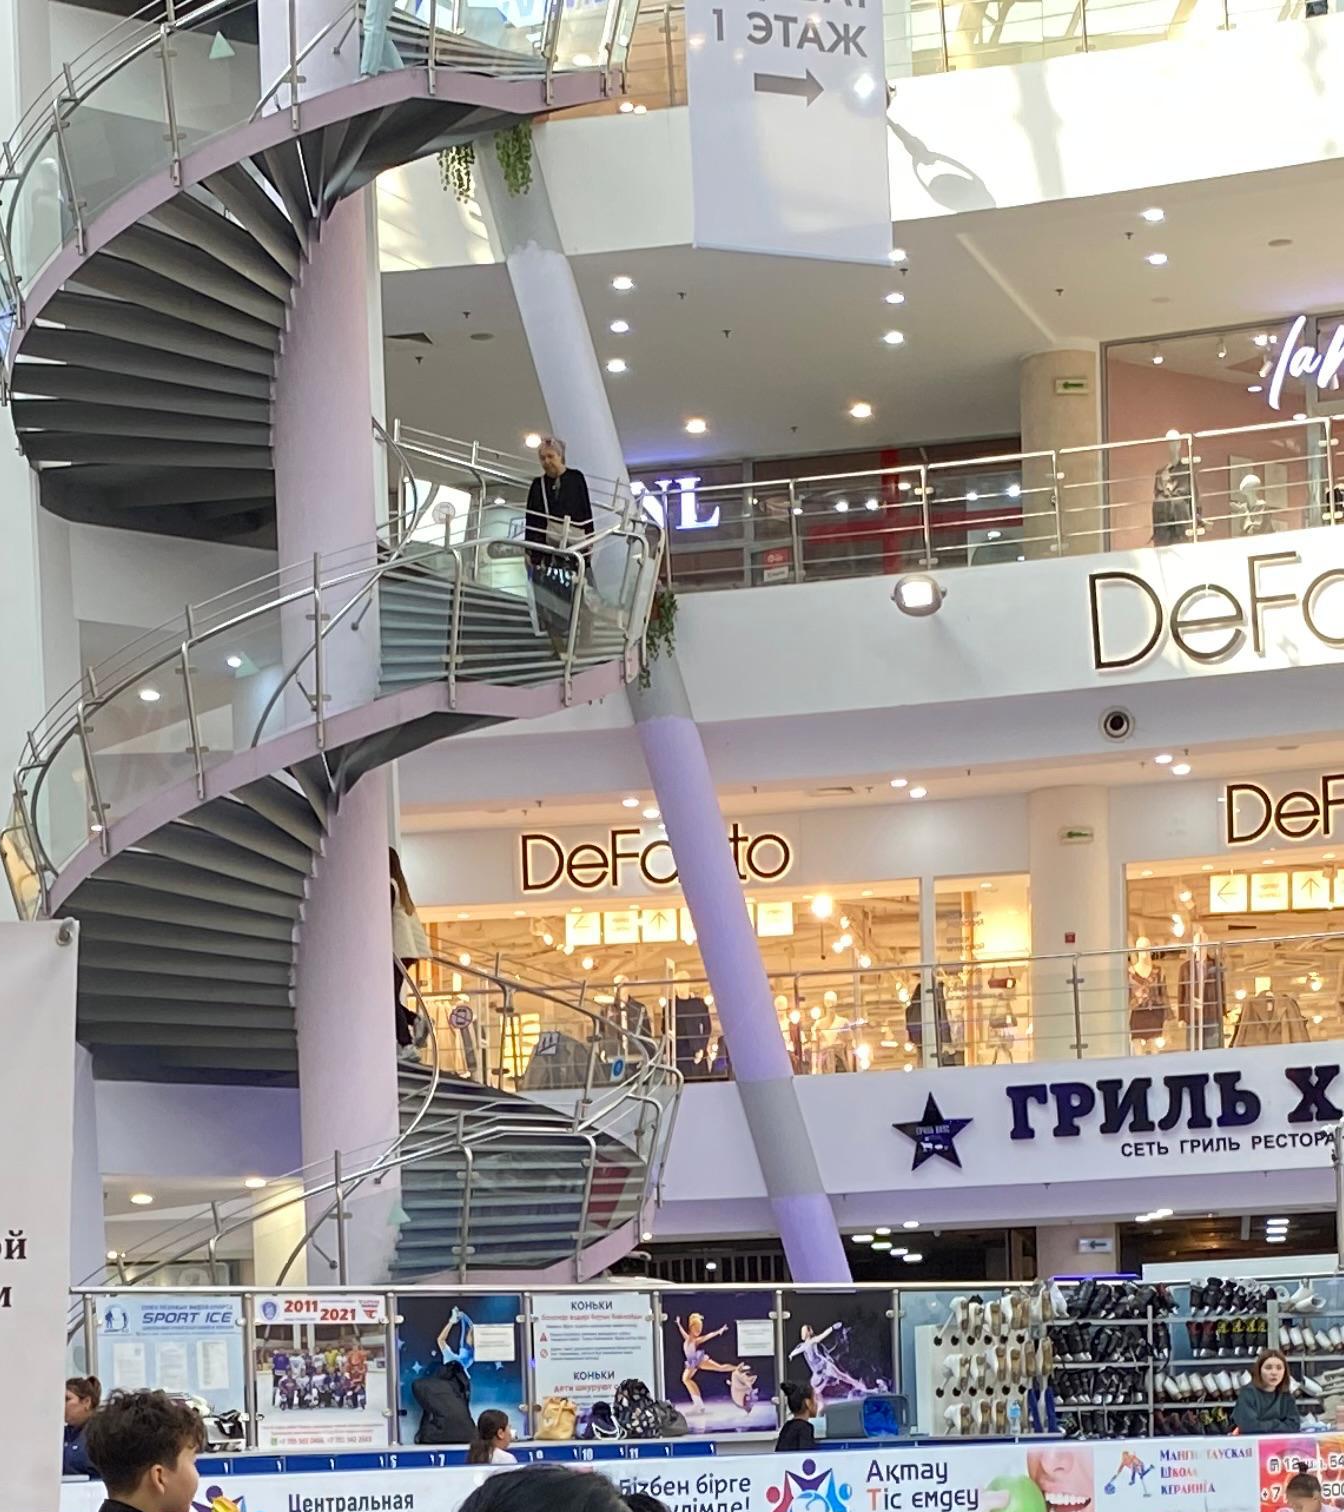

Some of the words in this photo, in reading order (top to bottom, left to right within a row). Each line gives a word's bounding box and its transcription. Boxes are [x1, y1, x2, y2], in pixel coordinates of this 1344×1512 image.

[746, 11, 869, 58] ЭТАЖ
[520, 823, 791, 893] DeFato
[1006, 1070, 1262, 1140] ГРИЛЬ
[1120, 1140, 1169, 1158] СЕТЬ
[1179, 1136, 1241, 1155] ГРИЛЬ
[284, 1300, 319, 1313] 2011
[320, 1308, 356, 1321] 2021
[141, 1312, 200, 1325] SPORT
[205, 1311, 233, 1324] ICE
